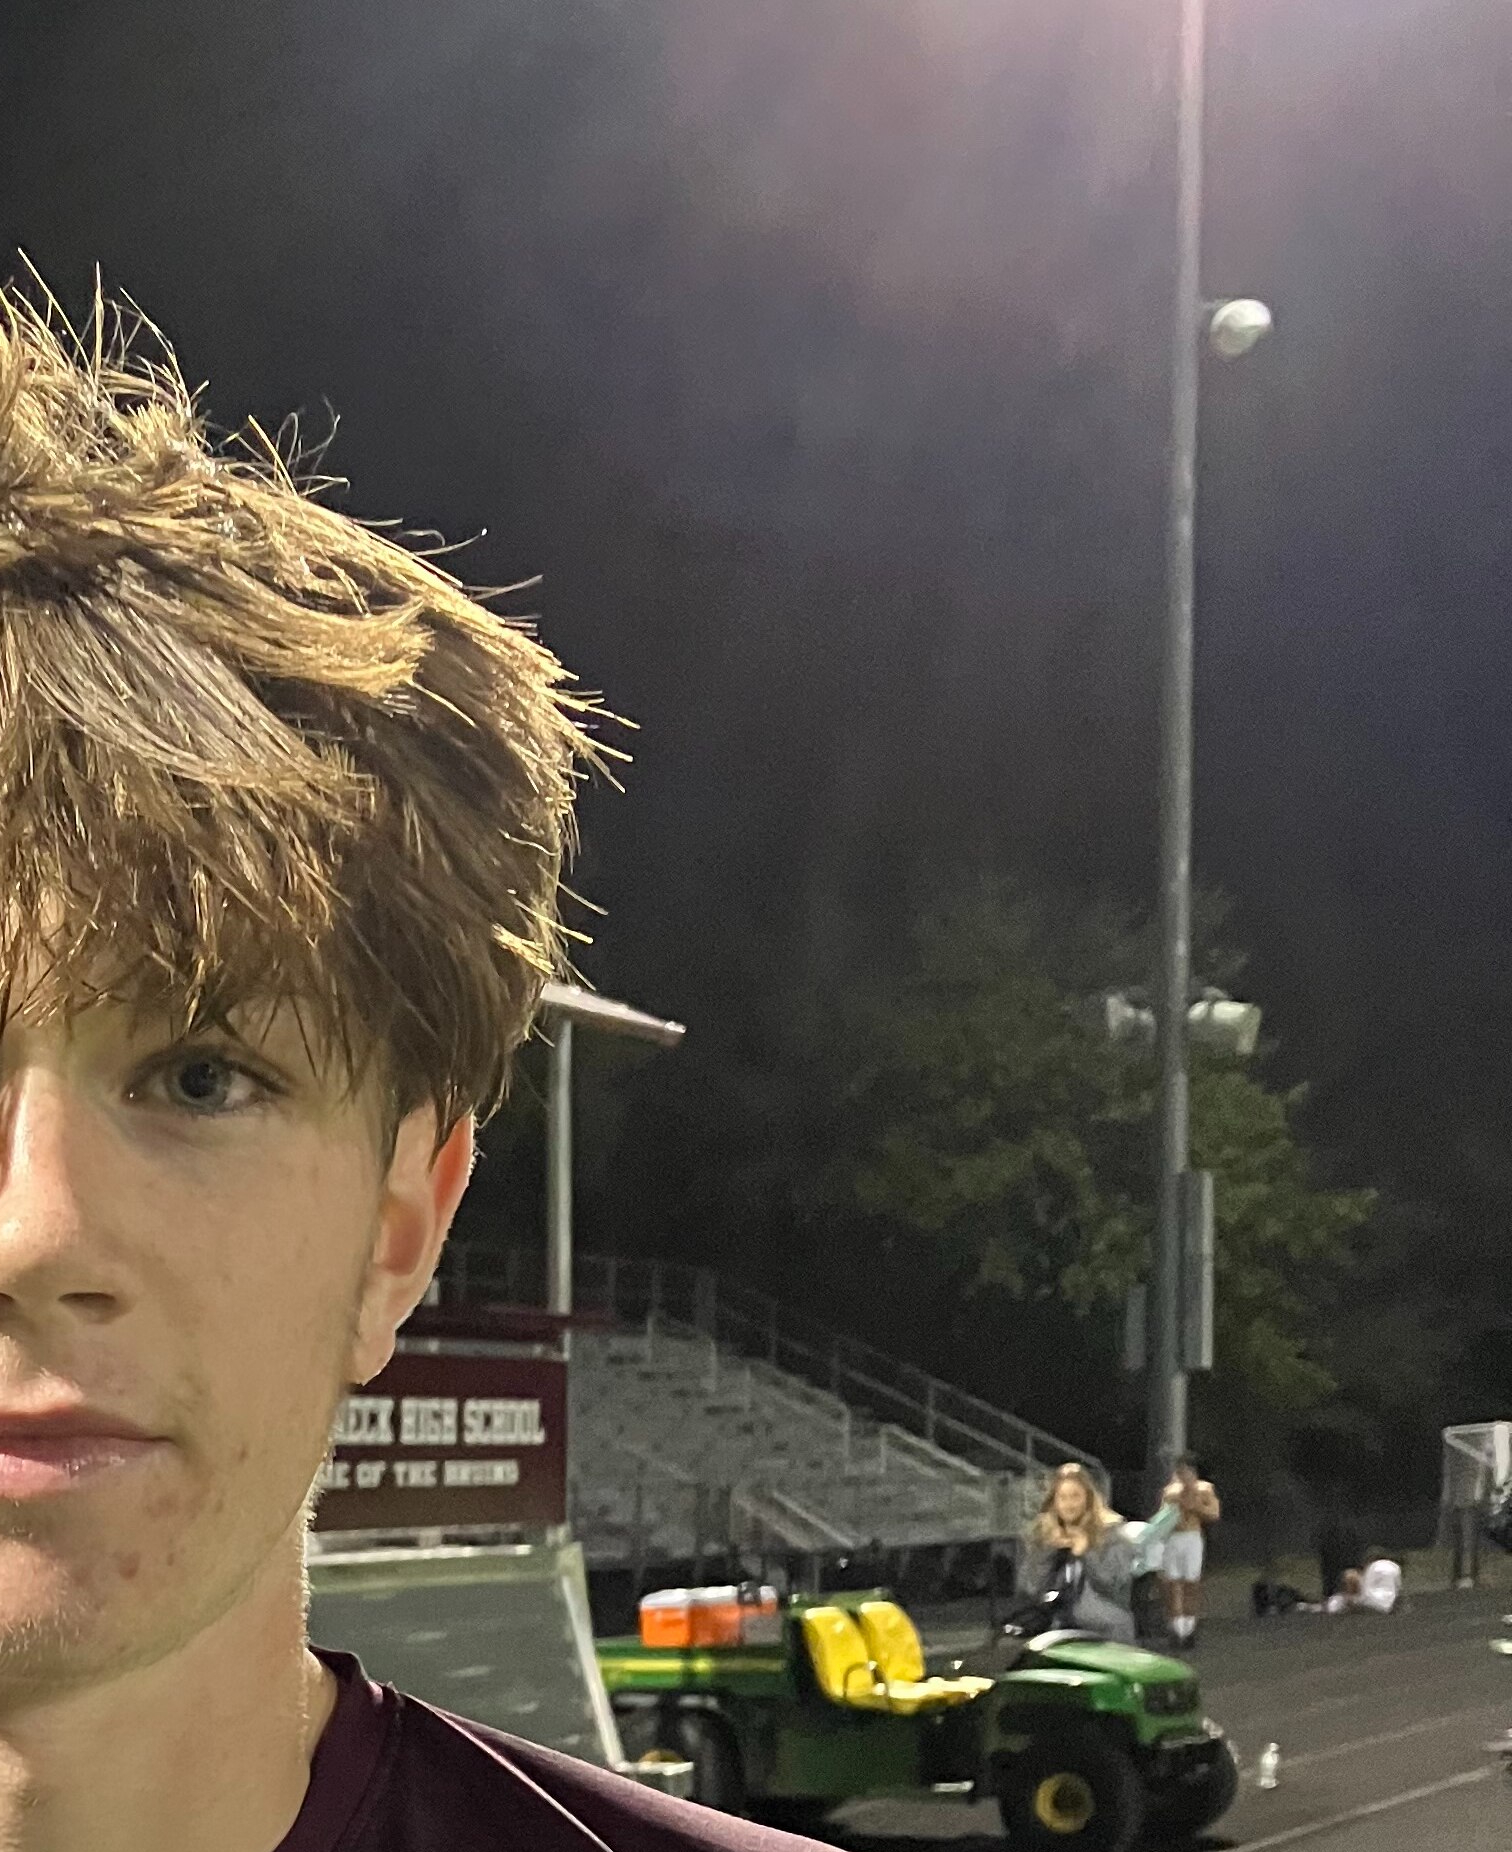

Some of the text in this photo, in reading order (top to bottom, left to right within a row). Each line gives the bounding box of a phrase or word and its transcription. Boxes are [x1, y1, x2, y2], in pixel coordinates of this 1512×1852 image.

[400, 1398, 458, 1445] HIGH
[463, 1398, 545, 1445] SCHOOL
[356, 1460, 386, 1488] OF
[393, 1460, 438, 1488] THE
